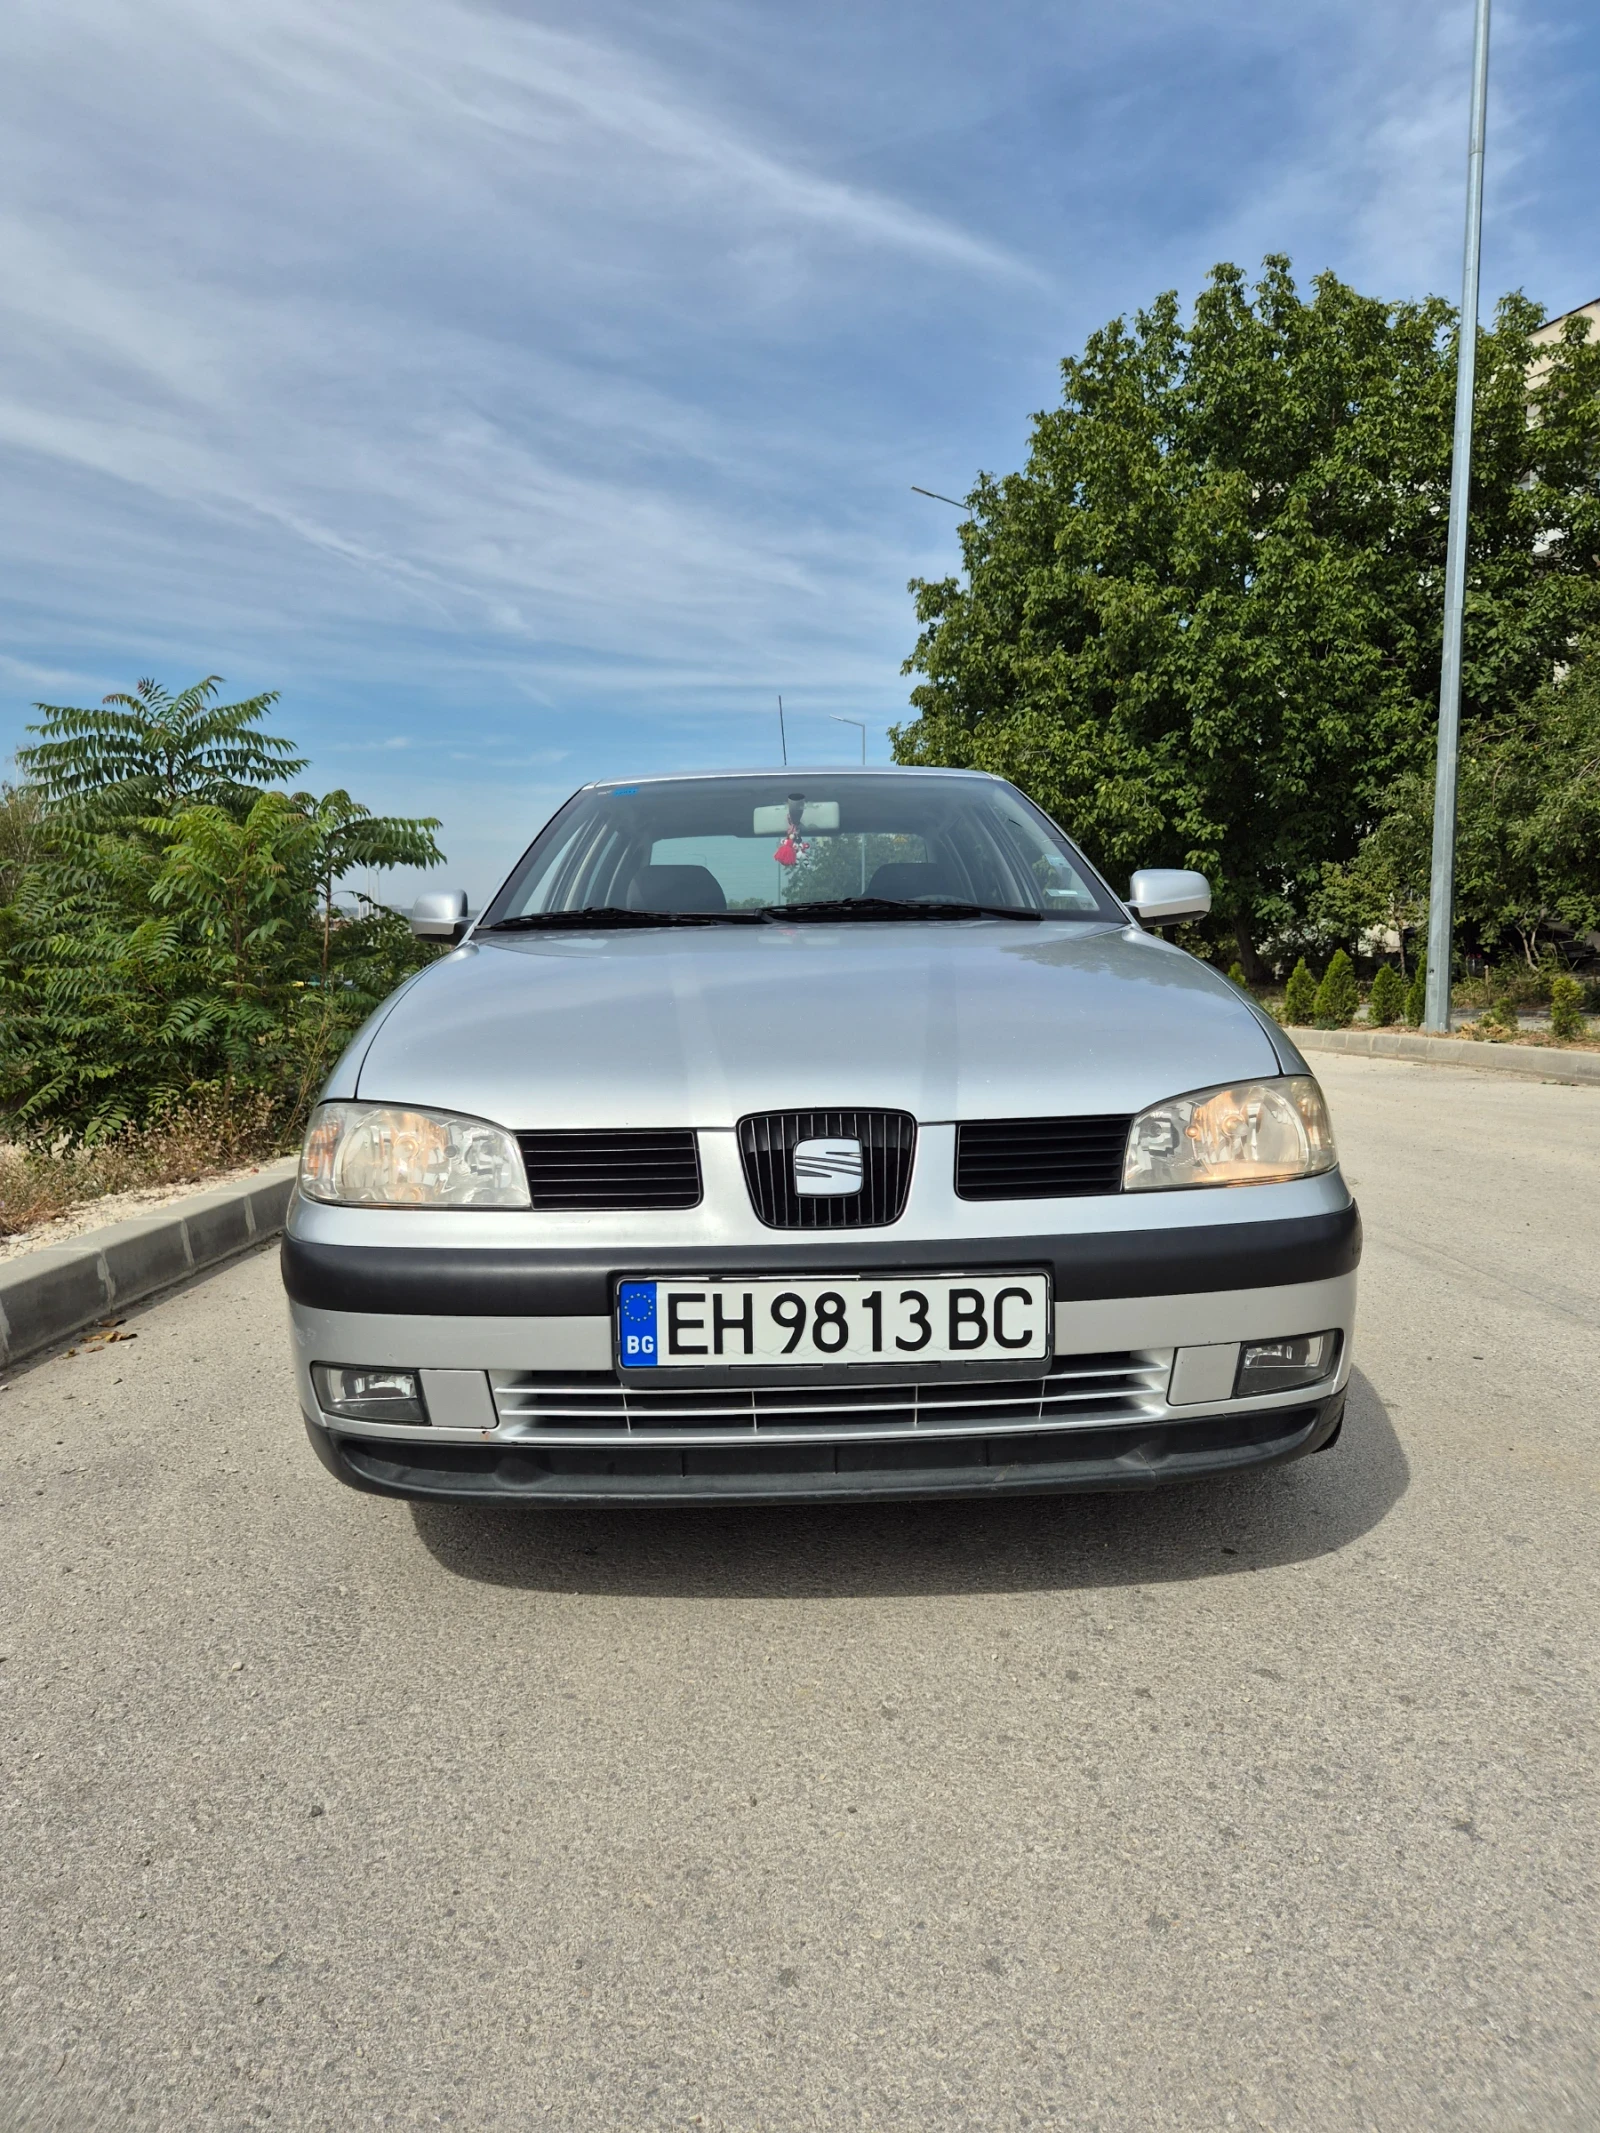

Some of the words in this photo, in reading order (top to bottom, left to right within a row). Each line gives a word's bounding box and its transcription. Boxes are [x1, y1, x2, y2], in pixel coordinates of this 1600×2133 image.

[667, 1292, 754, 1355] EH
[770, 1289, 932, 1354] 9813
[948, 1287, 1033, 1351] BC
[626, 1335, 655, 1355] BG
